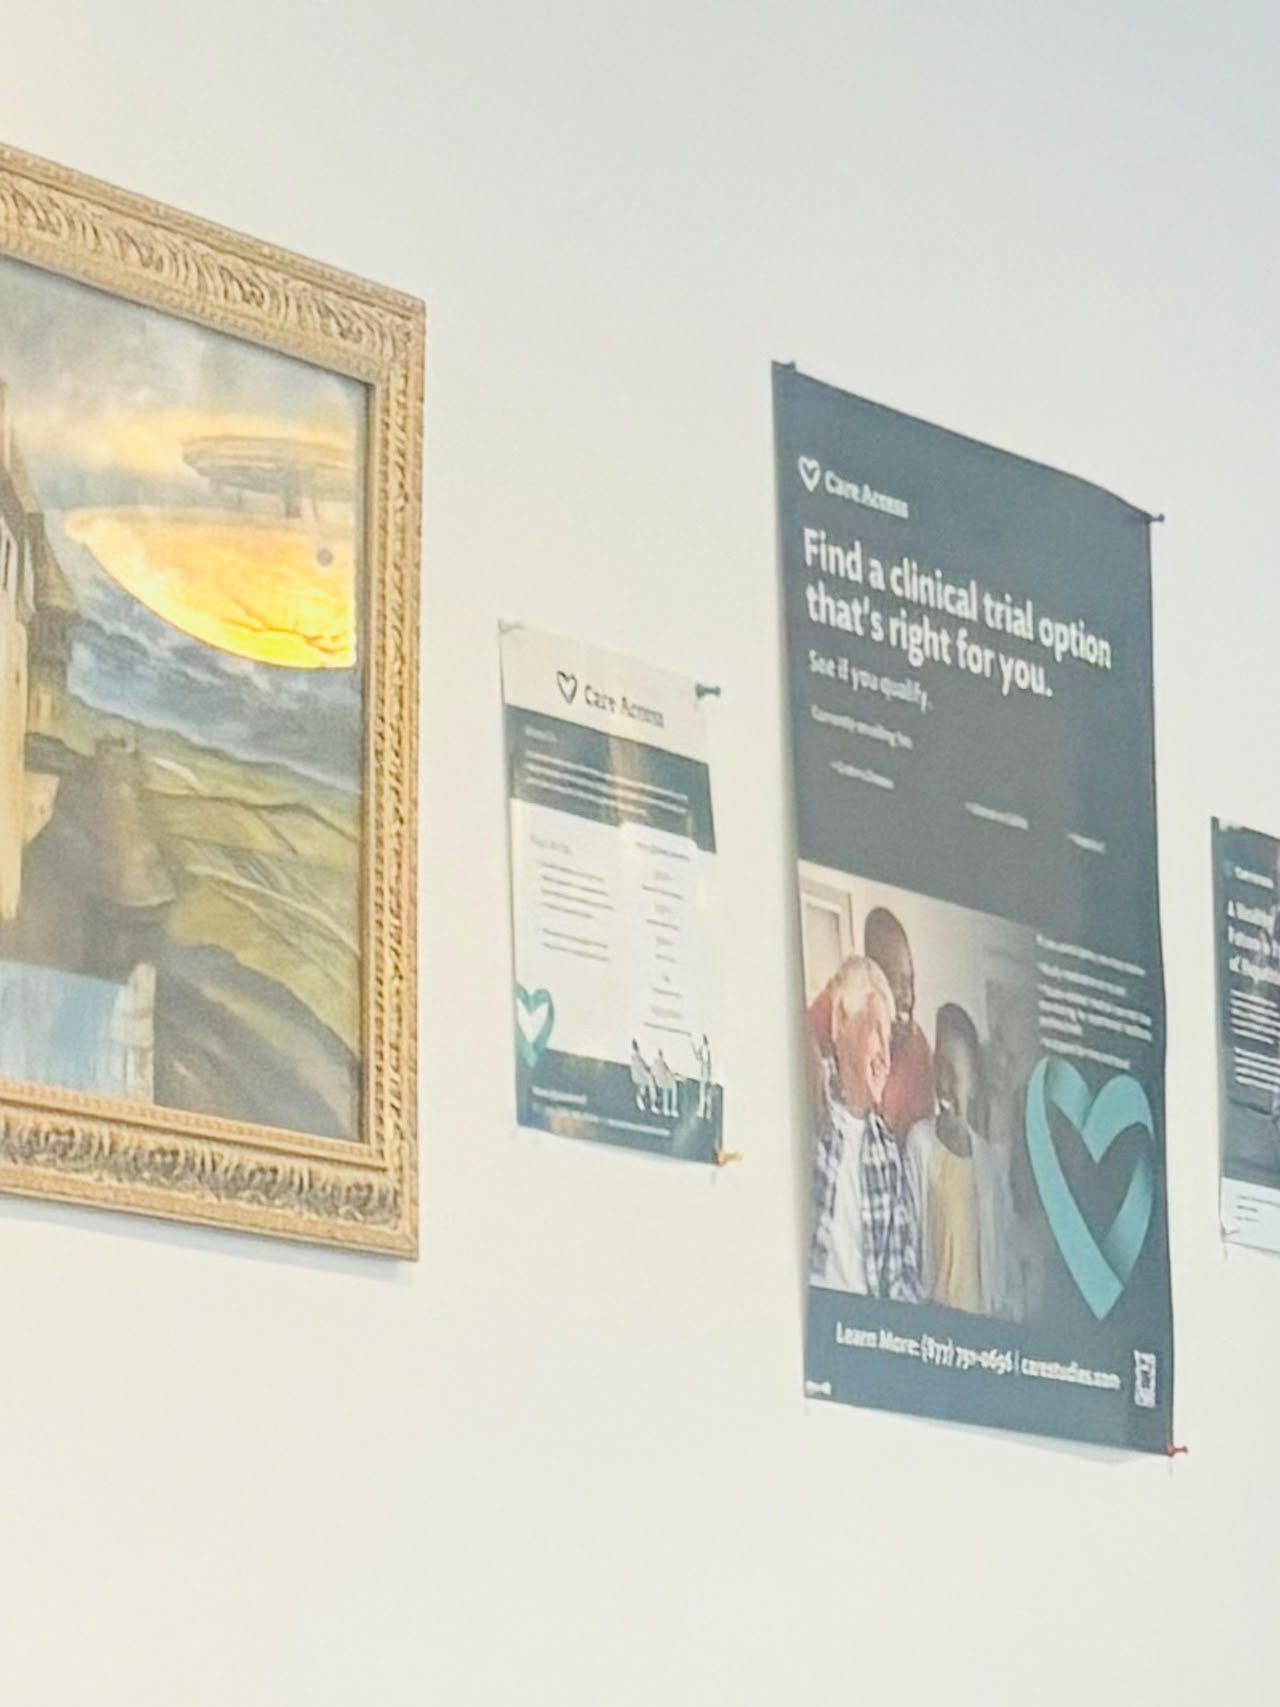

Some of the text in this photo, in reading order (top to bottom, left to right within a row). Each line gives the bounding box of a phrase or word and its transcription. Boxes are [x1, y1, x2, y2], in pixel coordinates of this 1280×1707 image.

[804, 527, 1112, 670] Find a clinical trial option
[806, 579, 1053, 697] that's right for you.
